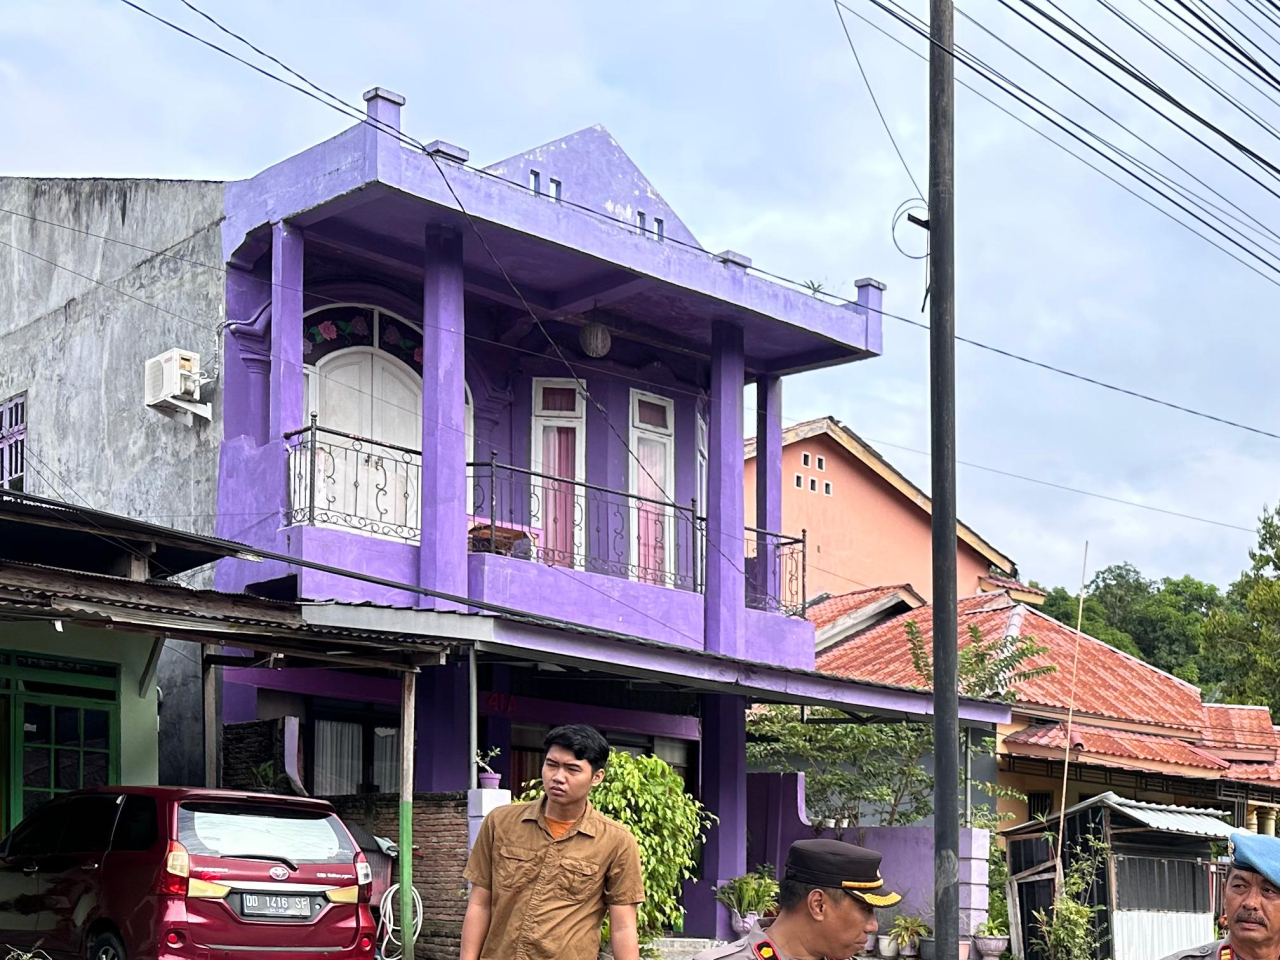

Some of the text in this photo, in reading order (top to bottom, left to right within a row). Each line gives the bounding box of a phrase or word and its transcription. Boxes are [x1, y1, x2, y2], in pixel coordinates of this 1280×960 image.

[246, 895, 308, 909] DD 1416 SF
